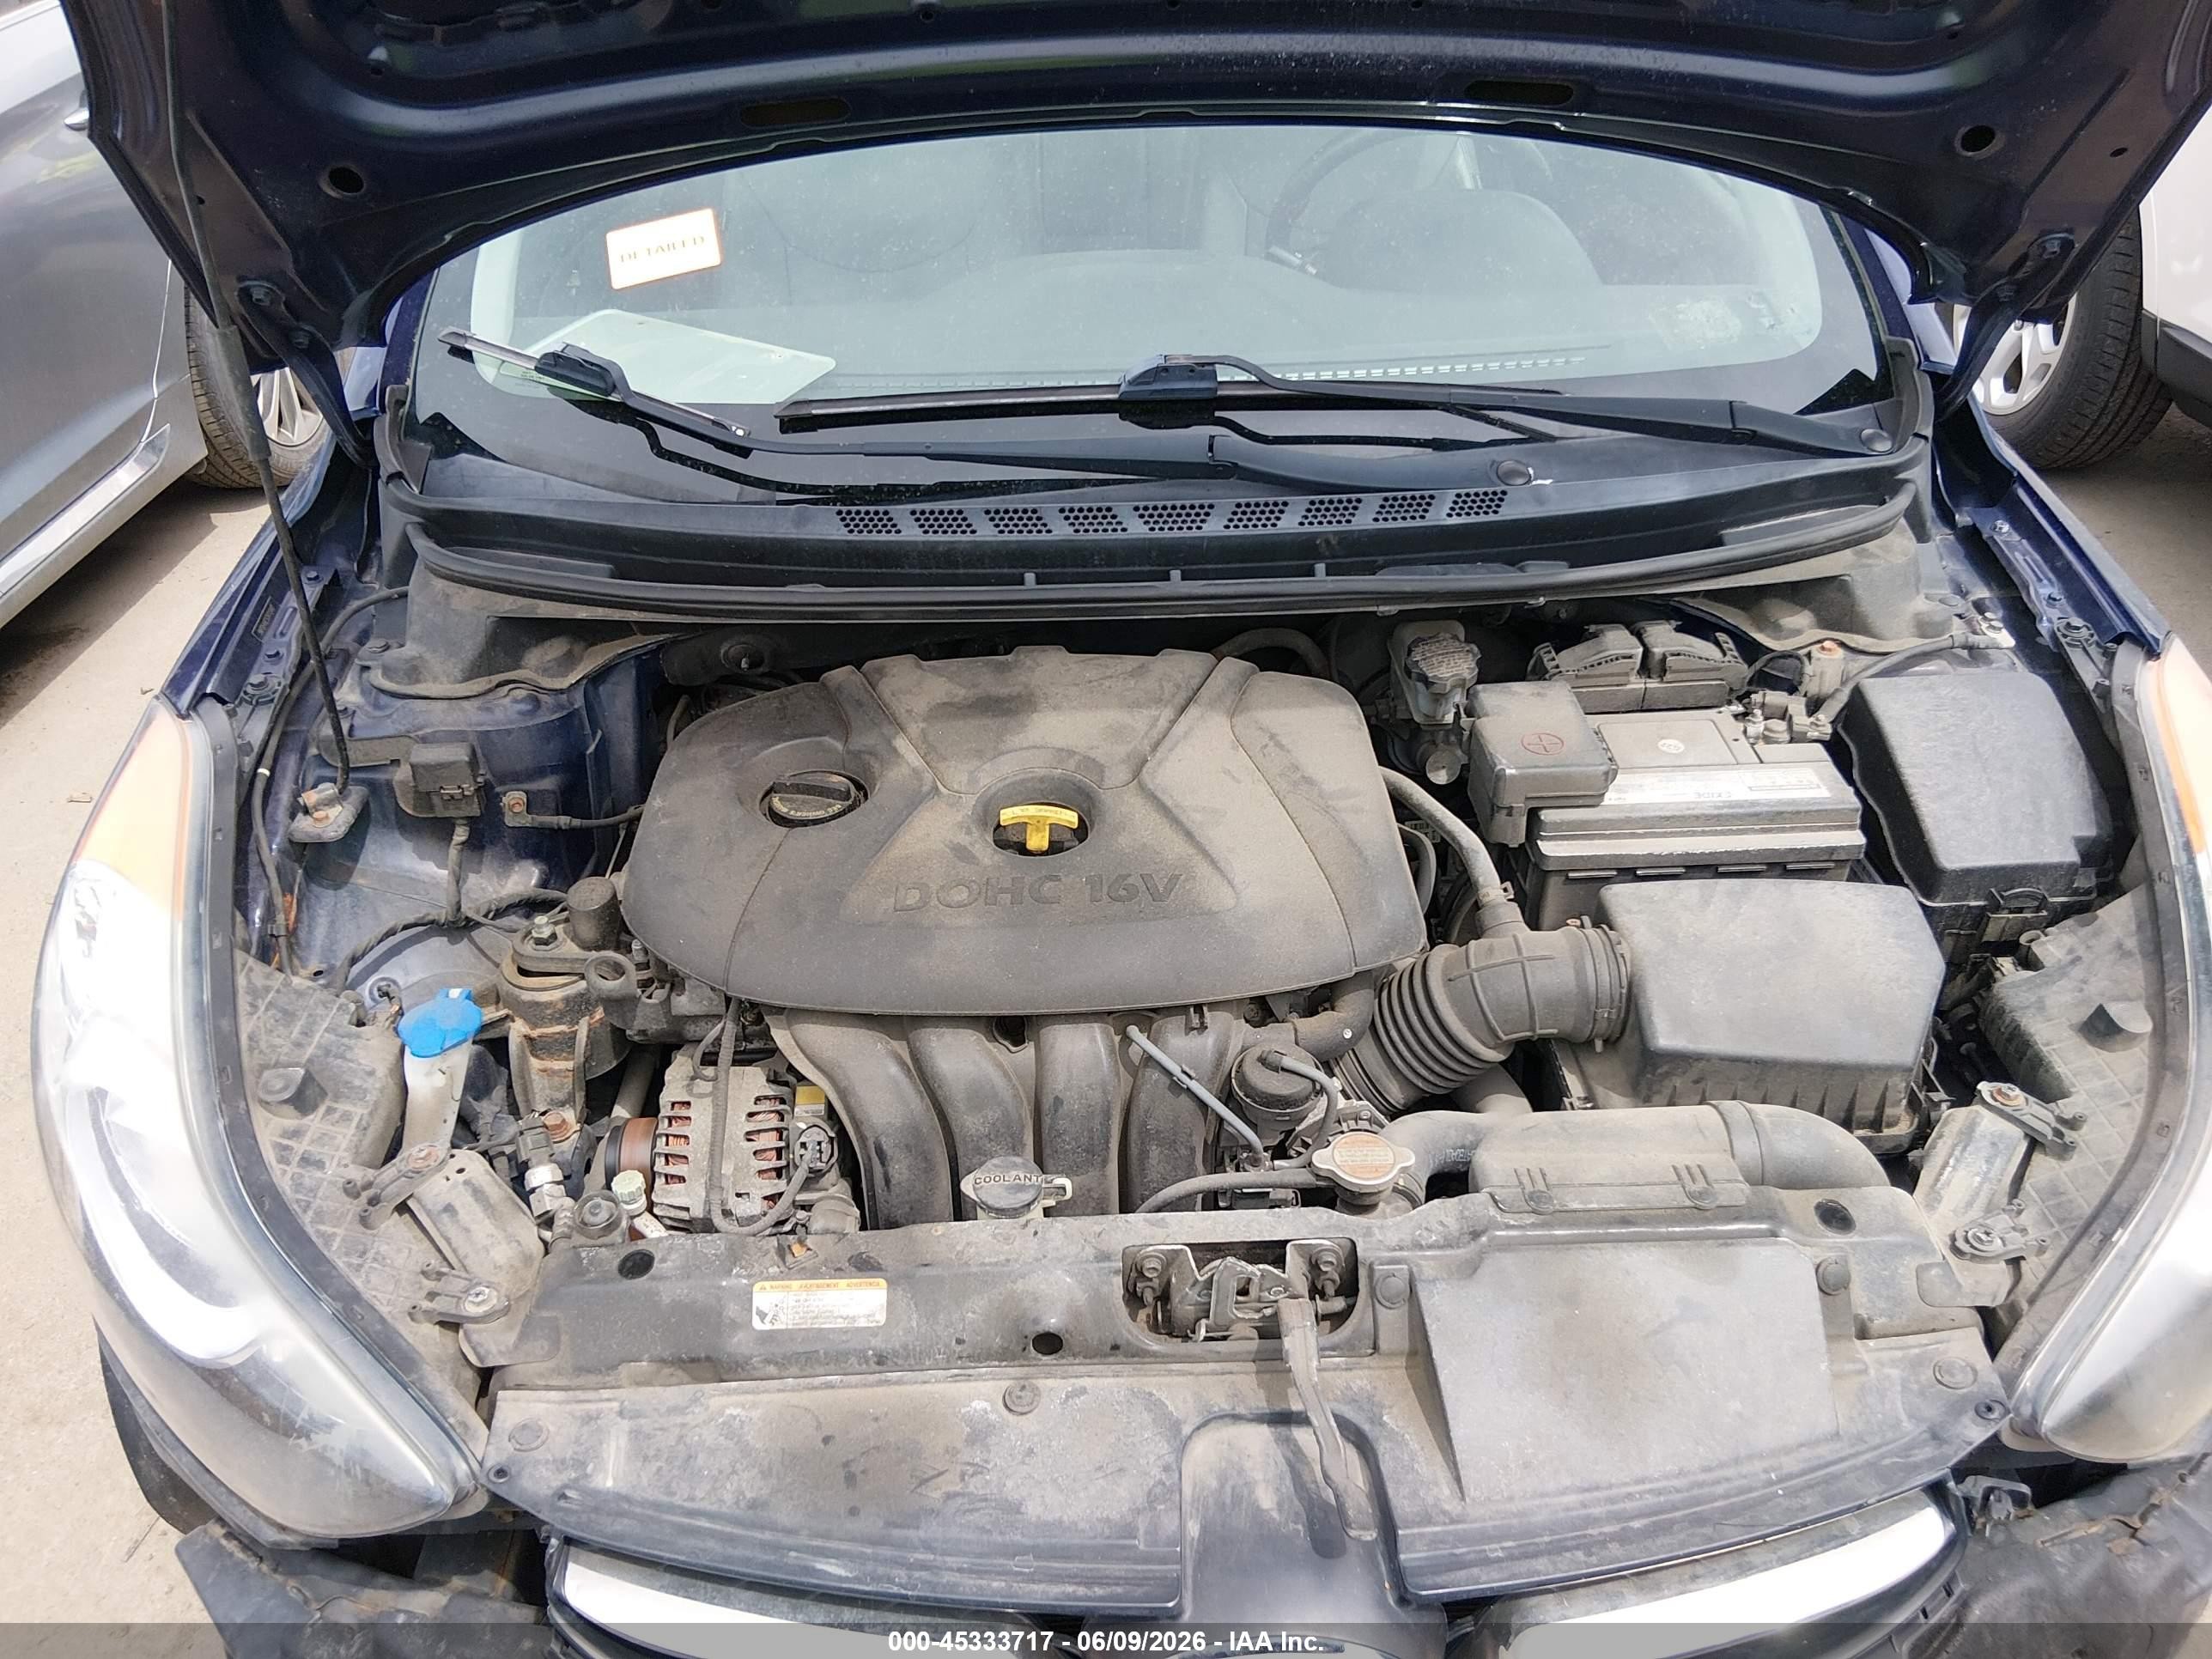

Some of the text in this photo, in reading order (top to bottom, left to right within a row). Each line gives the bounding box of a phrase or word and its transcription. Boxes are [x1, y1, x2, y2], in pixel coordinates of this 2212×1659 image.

[619, 235, 705, 263] DETAILED
[893, 872, 1183, 912] DOHC 16V
[974, 1174, 1043, 1186] COOLANT
